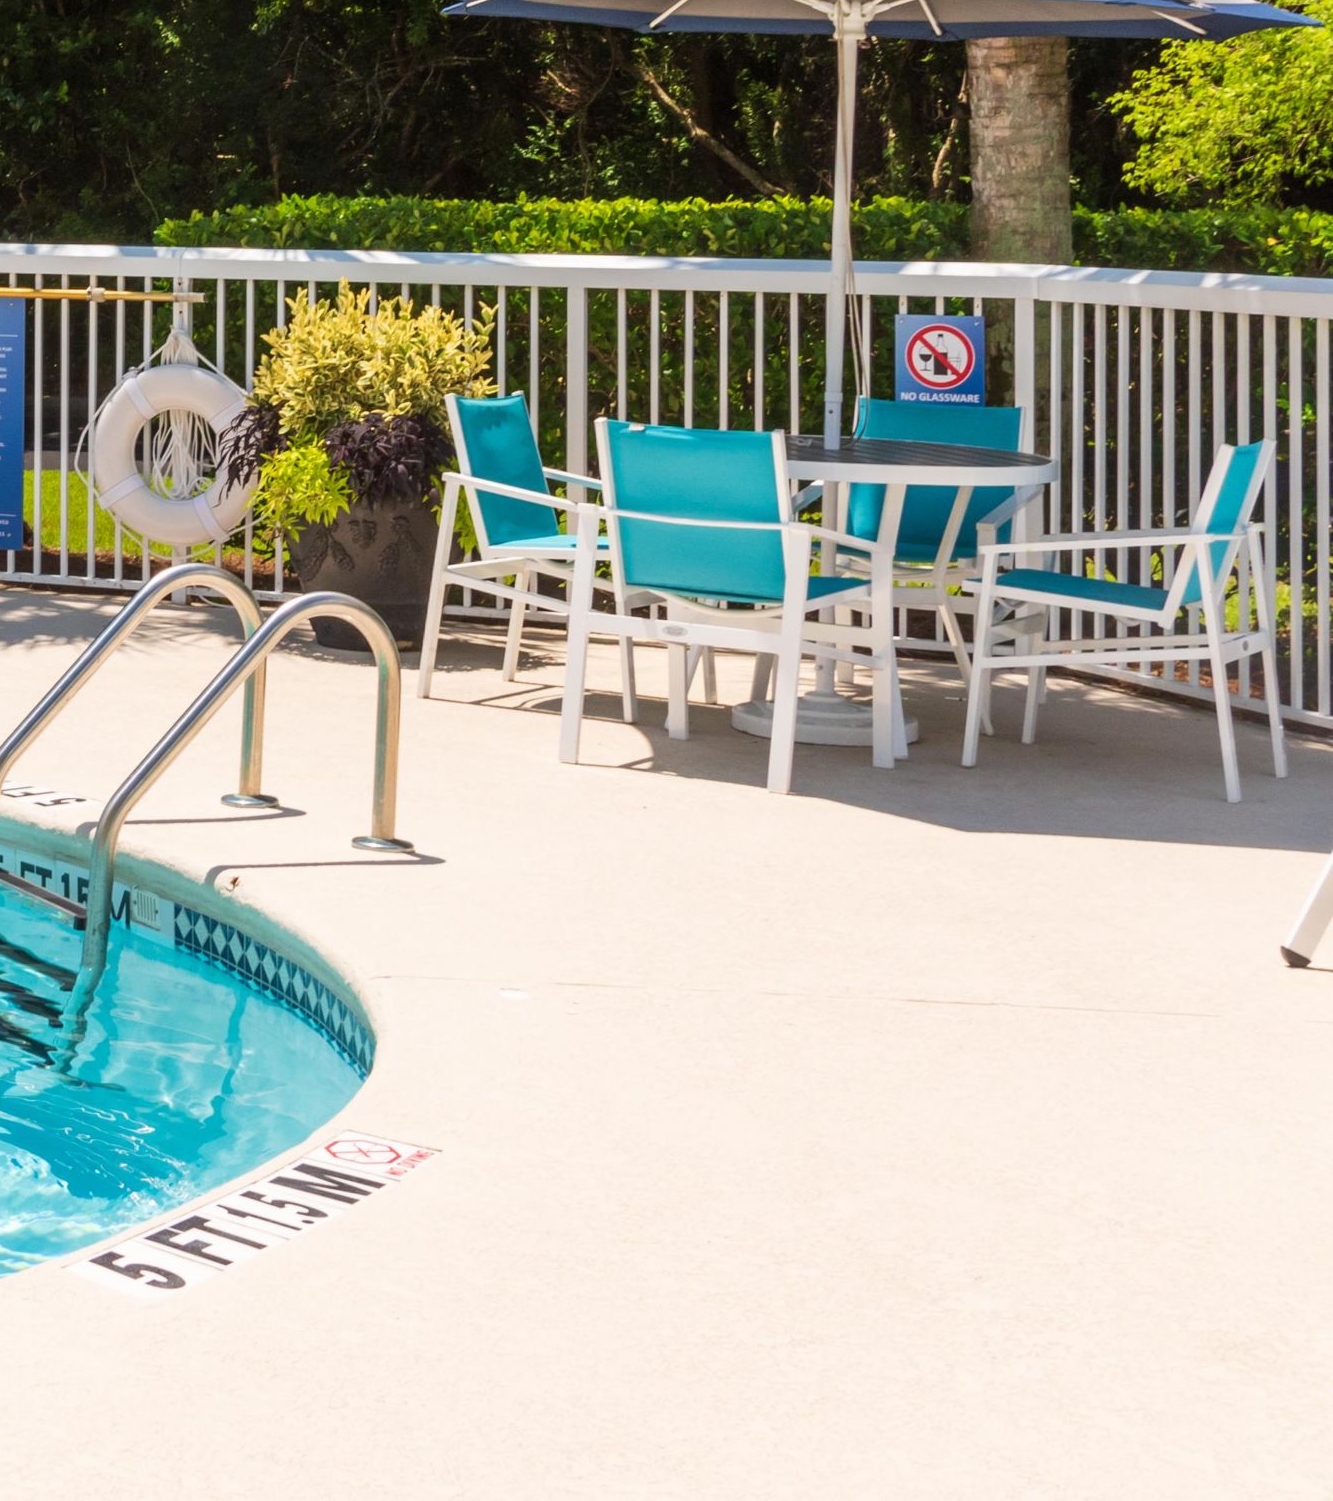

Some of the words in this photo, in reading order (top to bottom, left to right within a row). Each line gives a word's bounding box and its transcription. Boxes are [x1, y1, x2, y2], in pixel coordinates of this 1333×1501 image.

[900, 392, 916, 401] NO
[919, 393, 980, 403] GLASSWARE
[269, 1163, 386, 1205] M
[216, 1191, 328, 1231] 1.5
[144, 1216, 268, 1266] FT
[89, 1251, 186, 1290] 5
